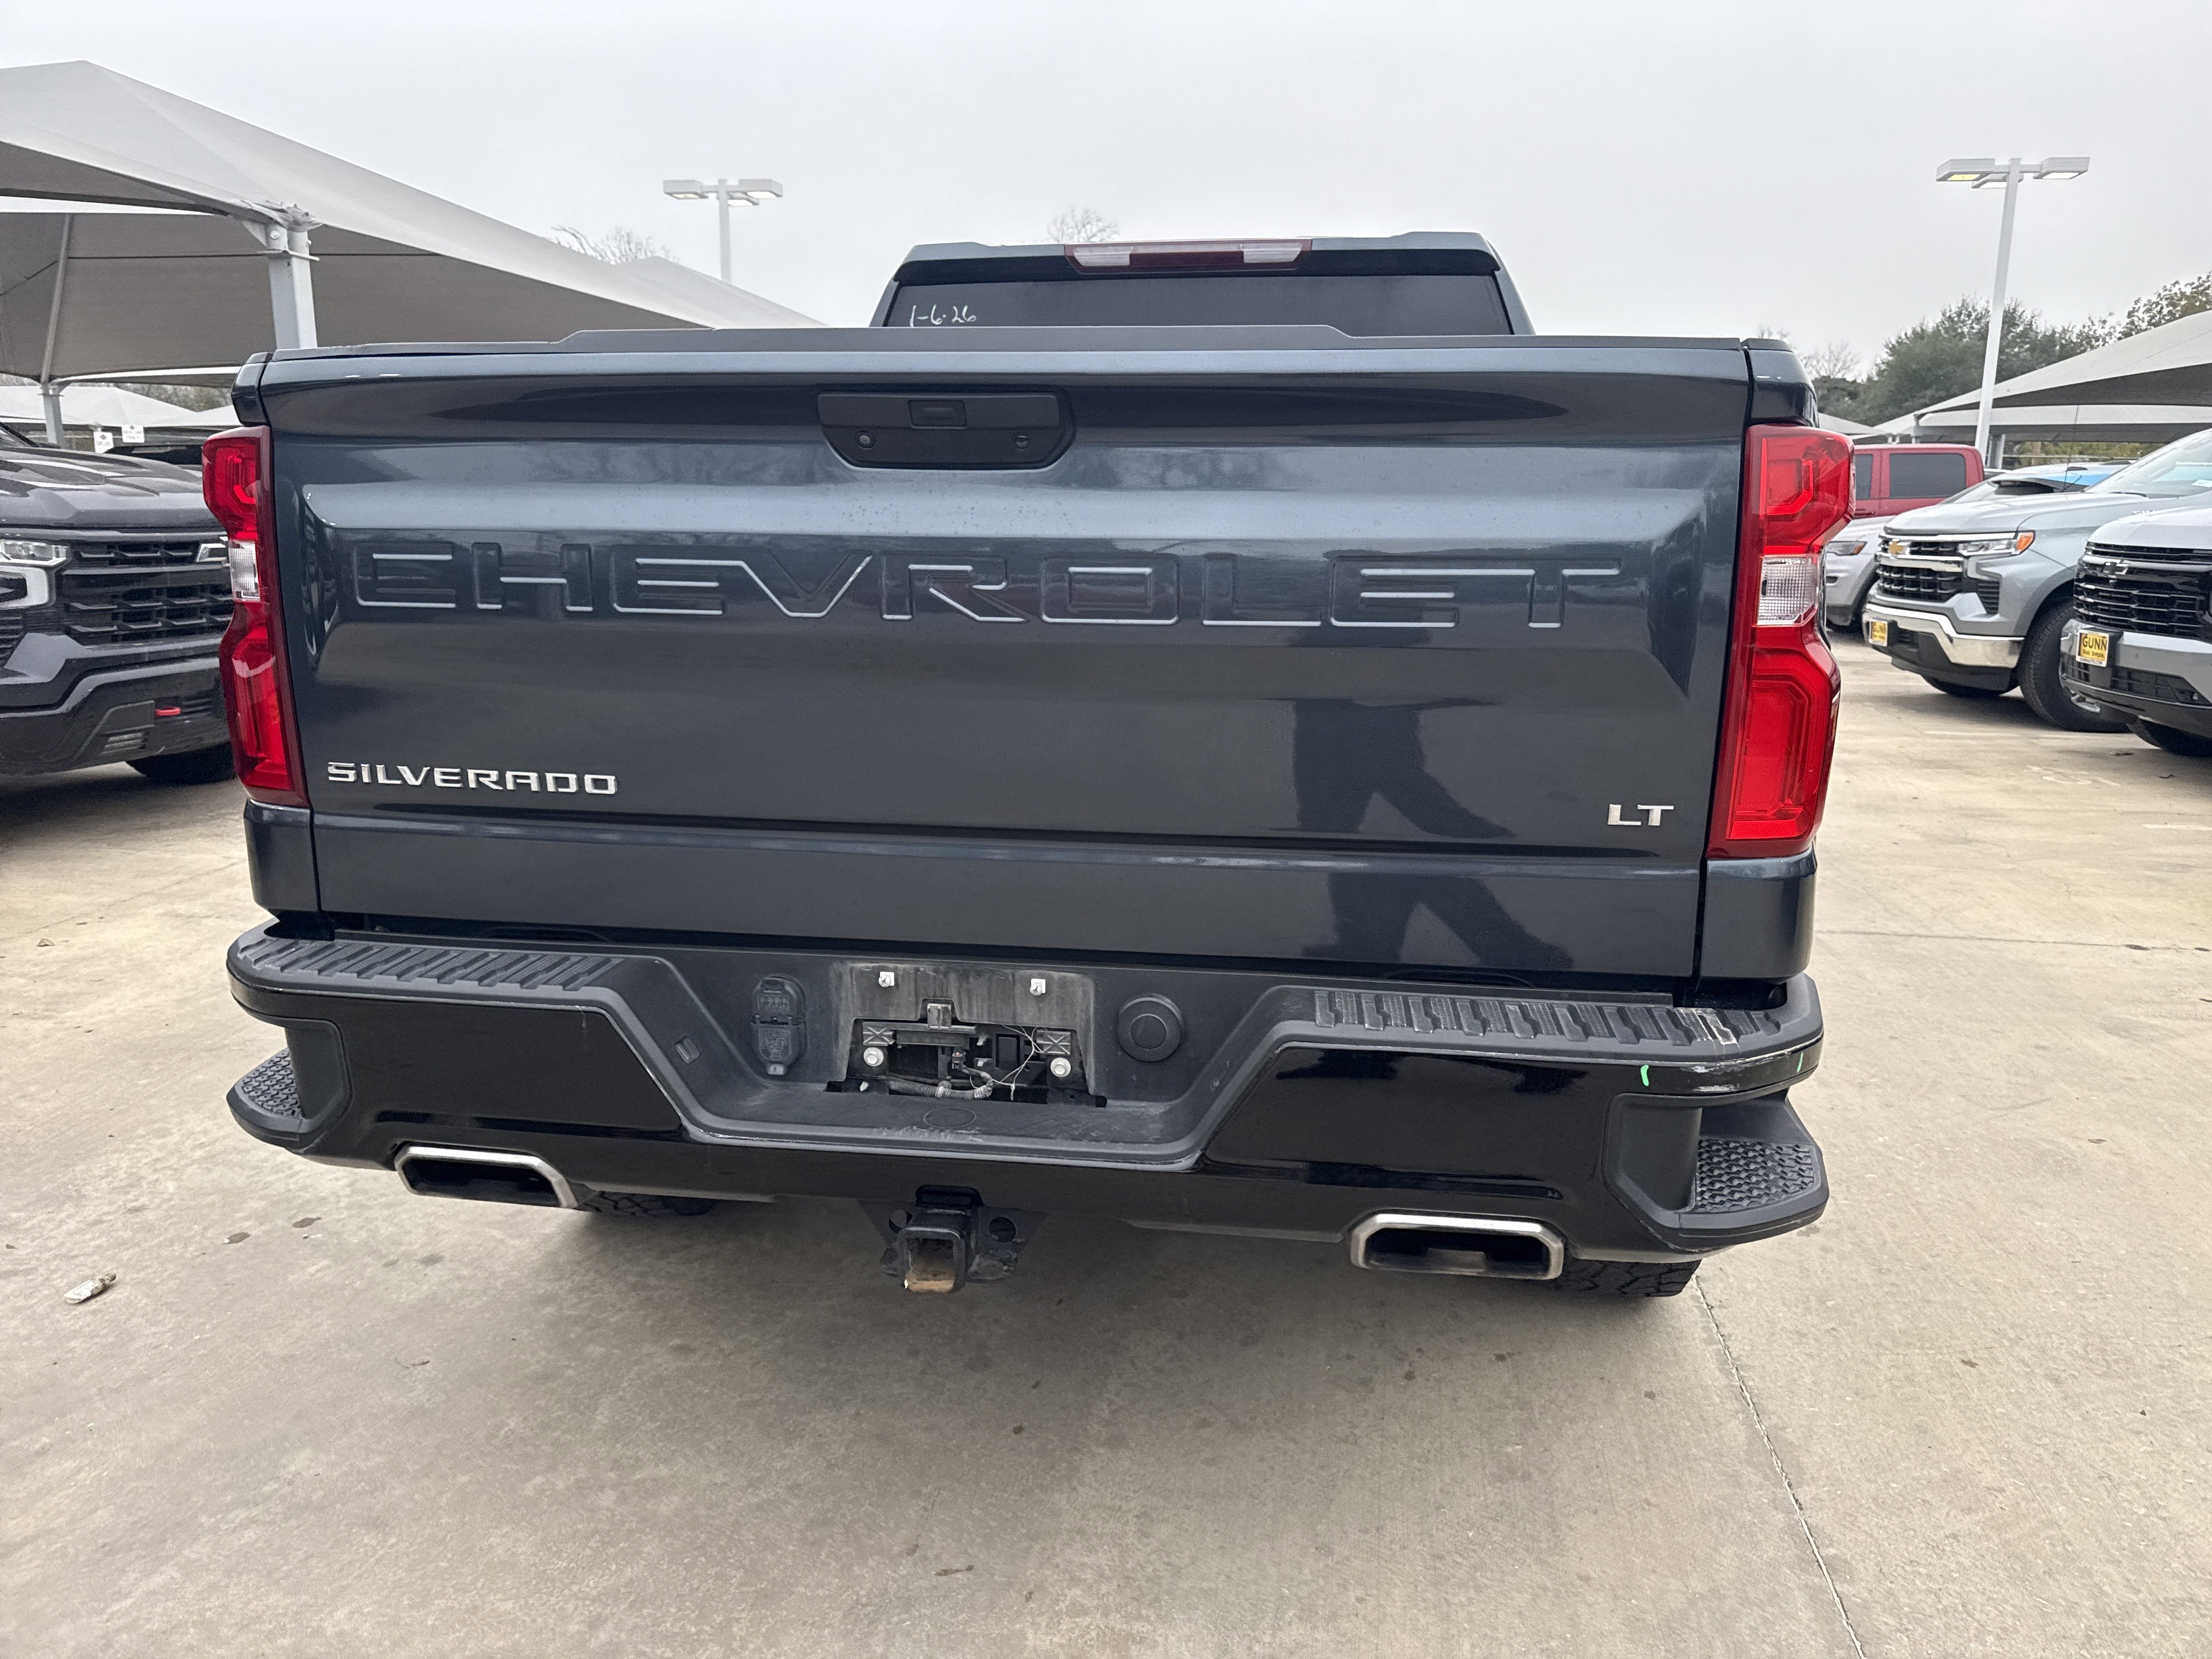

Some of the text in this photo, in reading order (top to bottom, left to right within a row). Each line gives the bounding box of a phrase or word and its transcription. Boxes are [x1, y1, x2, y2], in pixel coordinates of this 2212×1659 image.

[352, 540, 1622, 629] CHEVROLET
[2083, 635, 2107, 651] GUNN
[328, 761, 617, 795] SILVERADO
[1607, 804, 1674, 826] LT
